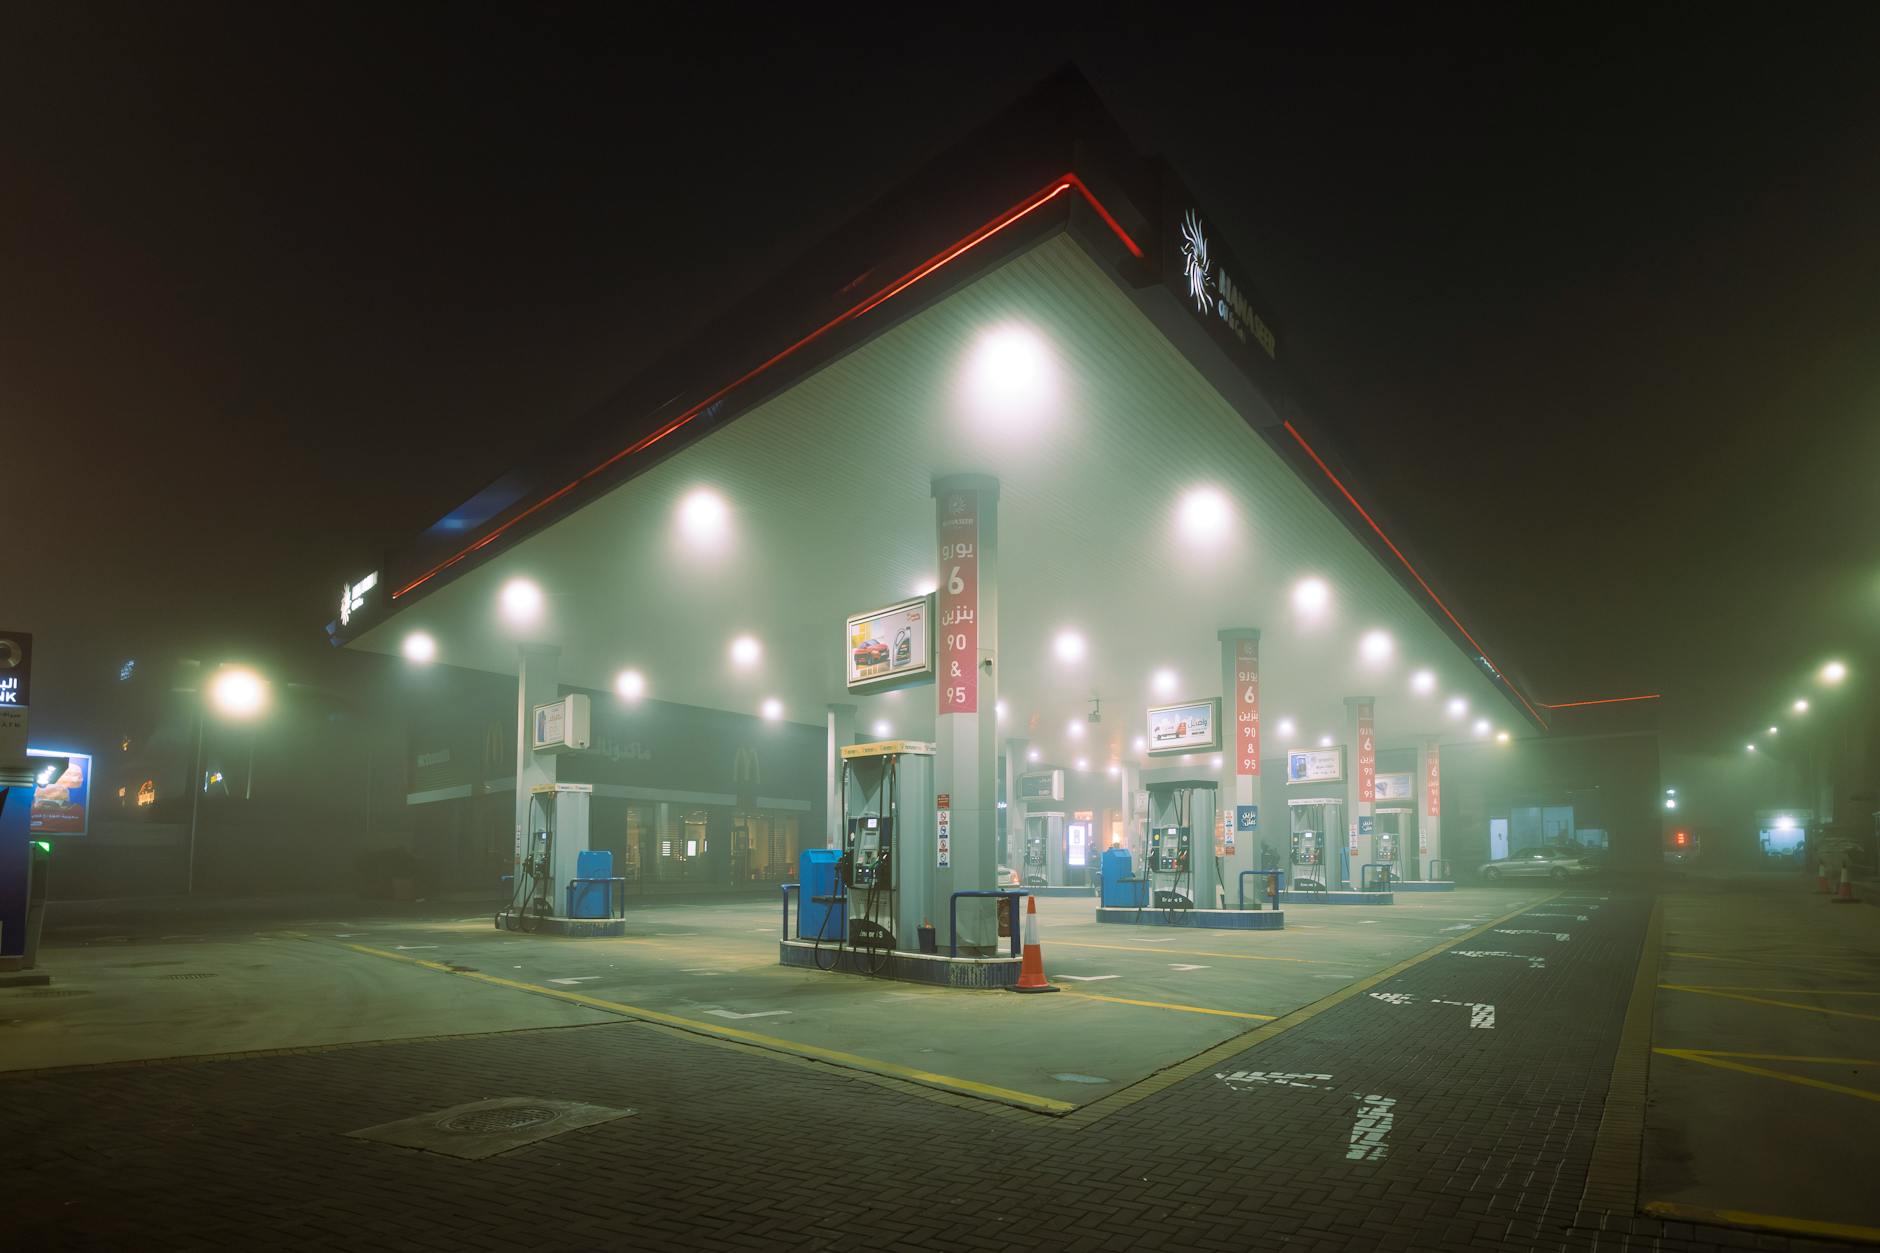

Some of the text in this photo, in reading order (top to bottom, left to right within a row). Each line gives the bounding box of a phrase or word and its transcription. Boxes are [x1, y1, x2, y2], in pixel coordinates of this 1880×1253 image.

[942, 543, 974, 560] يورو
[947, 566, 964, 595] 6
[942, 605, 974, 626] بنزين
[947, 634, 967, 652] 90
[950, 660, 962, 677] &
[946, 687, 966, 704] 95
[1244, 686, 1255, 704] 6
[1244, 727, 1256, 738] 90
[1247, 743, 1254, 754] &
[1363, 737, 1372, 751] 6
[1244, 759, 1256, 770] 95
